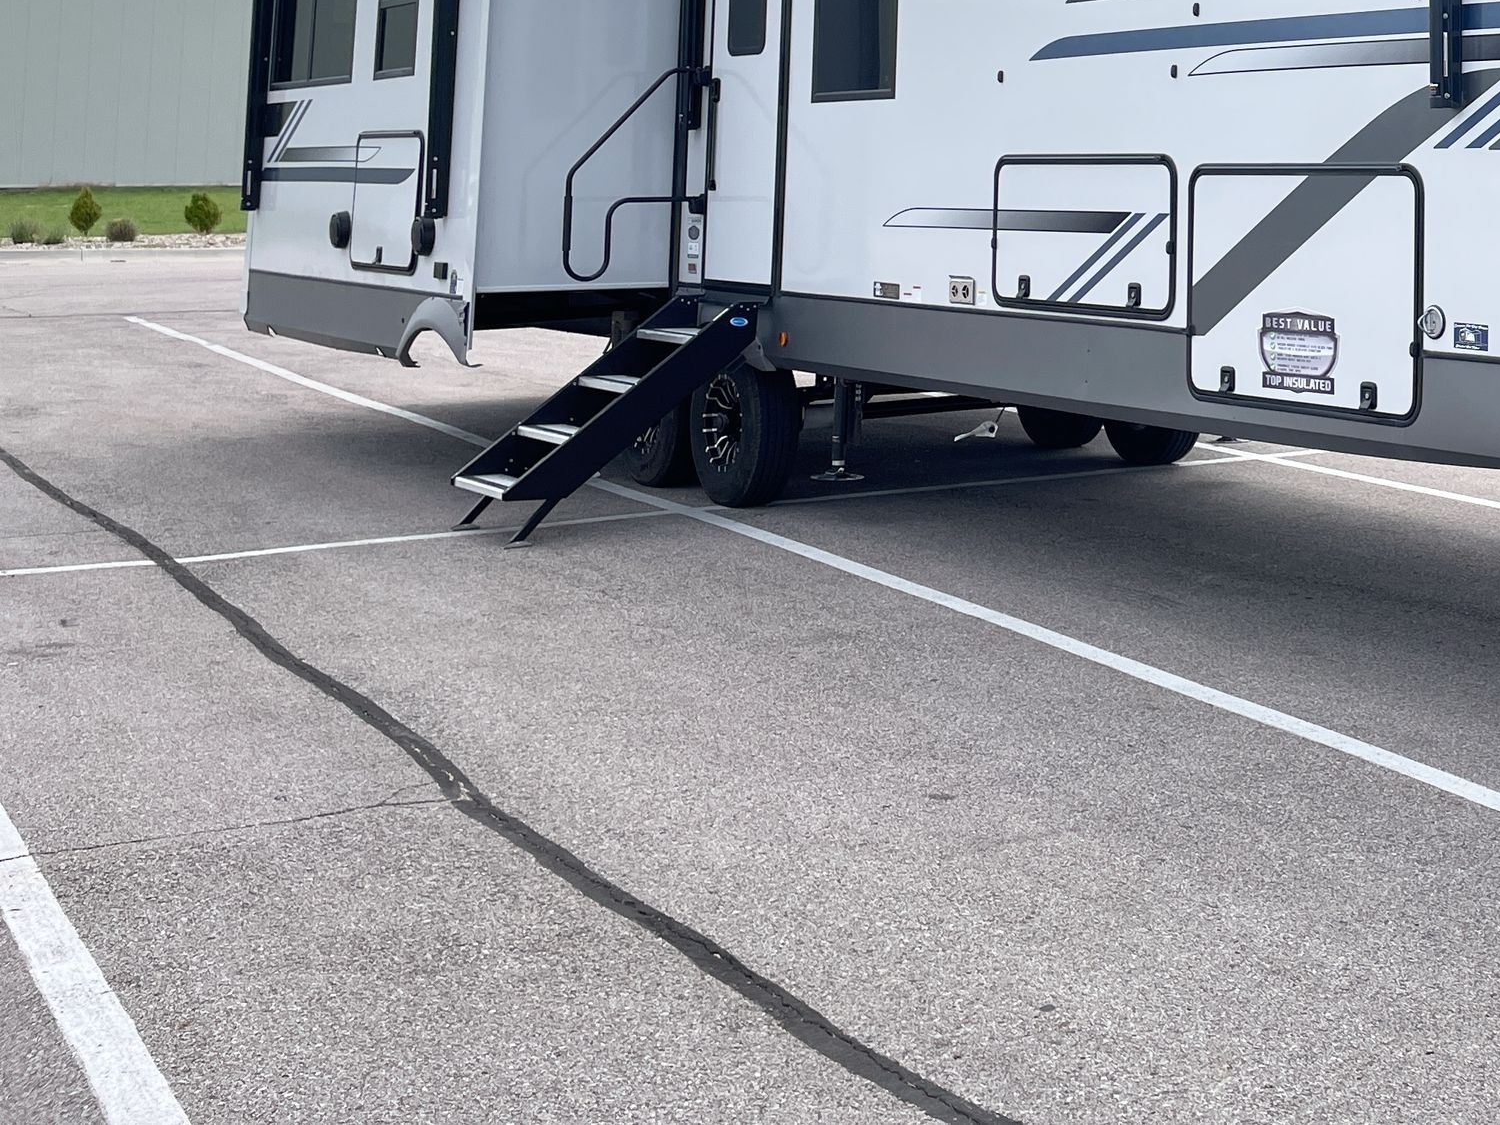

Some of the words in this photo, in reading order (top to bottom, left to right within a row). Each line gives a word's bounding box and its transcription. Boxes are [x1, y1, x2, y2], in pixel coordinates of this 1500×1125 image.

[1265, 317, 1292, 329] BEST
[1297, 319, 1332, 332] VALUE
[1265, 375, 1281, 386] TOP
[1283, 376, 1332, 391] INSULATED
